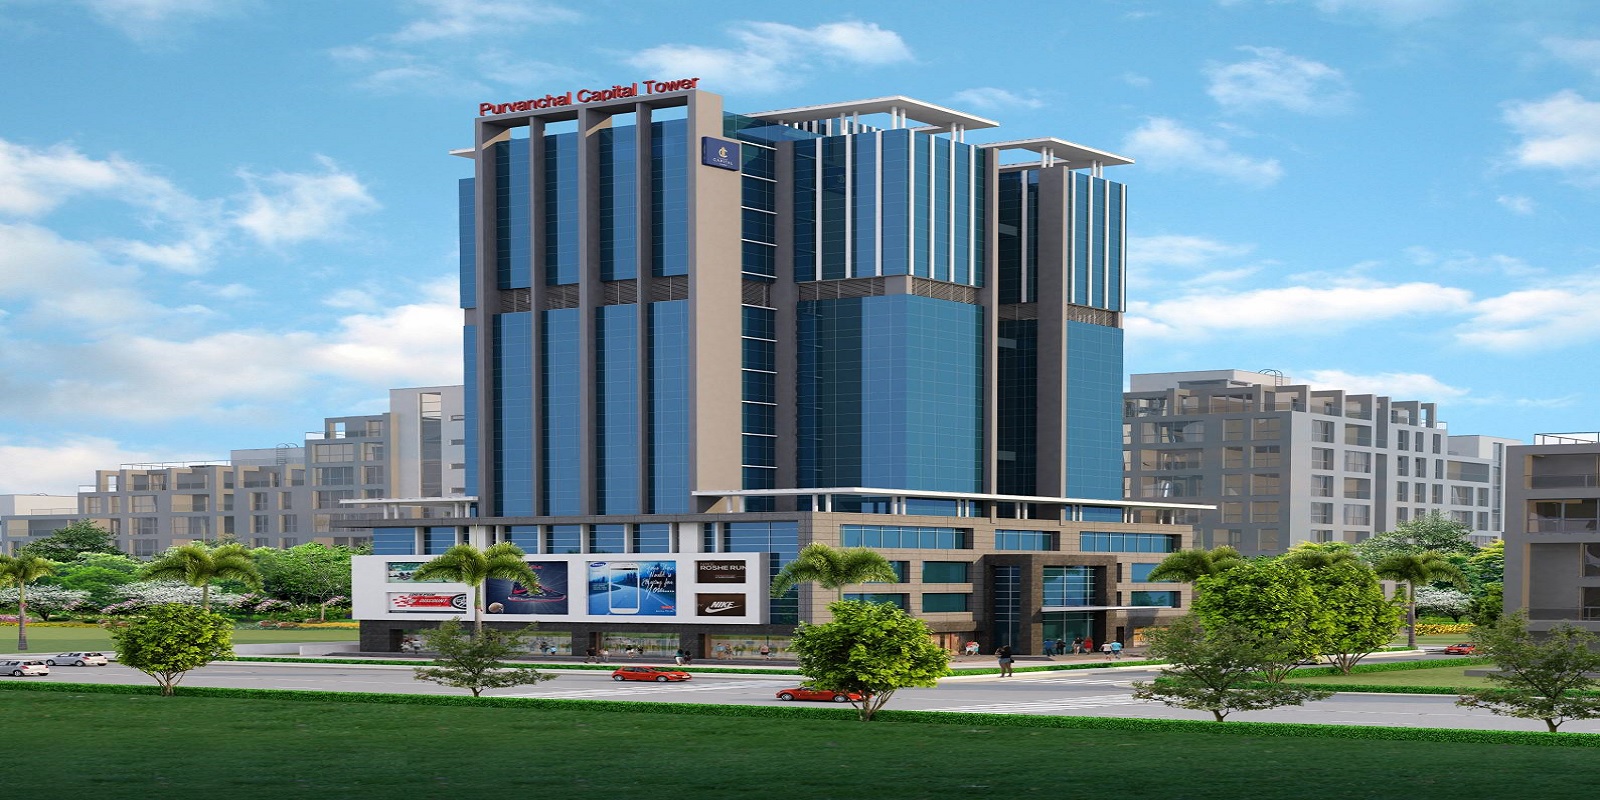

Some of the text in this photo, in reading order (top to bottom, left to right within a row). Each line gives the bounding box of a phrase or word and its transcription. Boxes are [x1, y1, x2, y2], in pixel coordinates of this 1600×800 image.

[479, 77, 700, 116] Purvanchal Capital Tower
